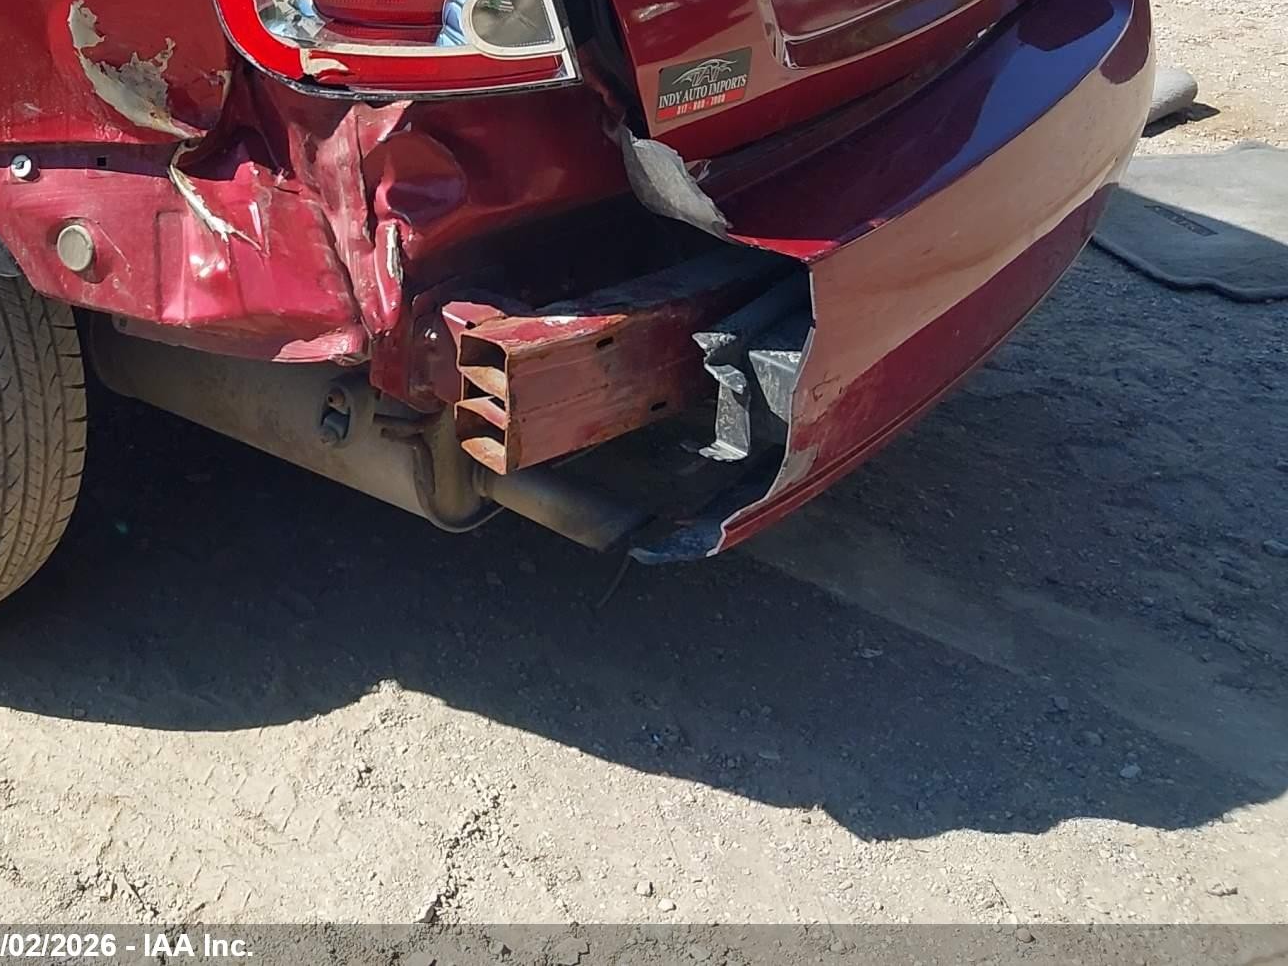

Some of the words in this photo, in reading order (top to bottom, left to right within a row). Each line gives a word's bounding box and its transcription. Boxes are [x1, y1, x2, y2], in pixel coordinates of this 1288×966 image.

[658, 91, 683, 109] INDY
[682, 84, 708, 103] AUTO
[708, 74, 748, 95] IMPORTS
